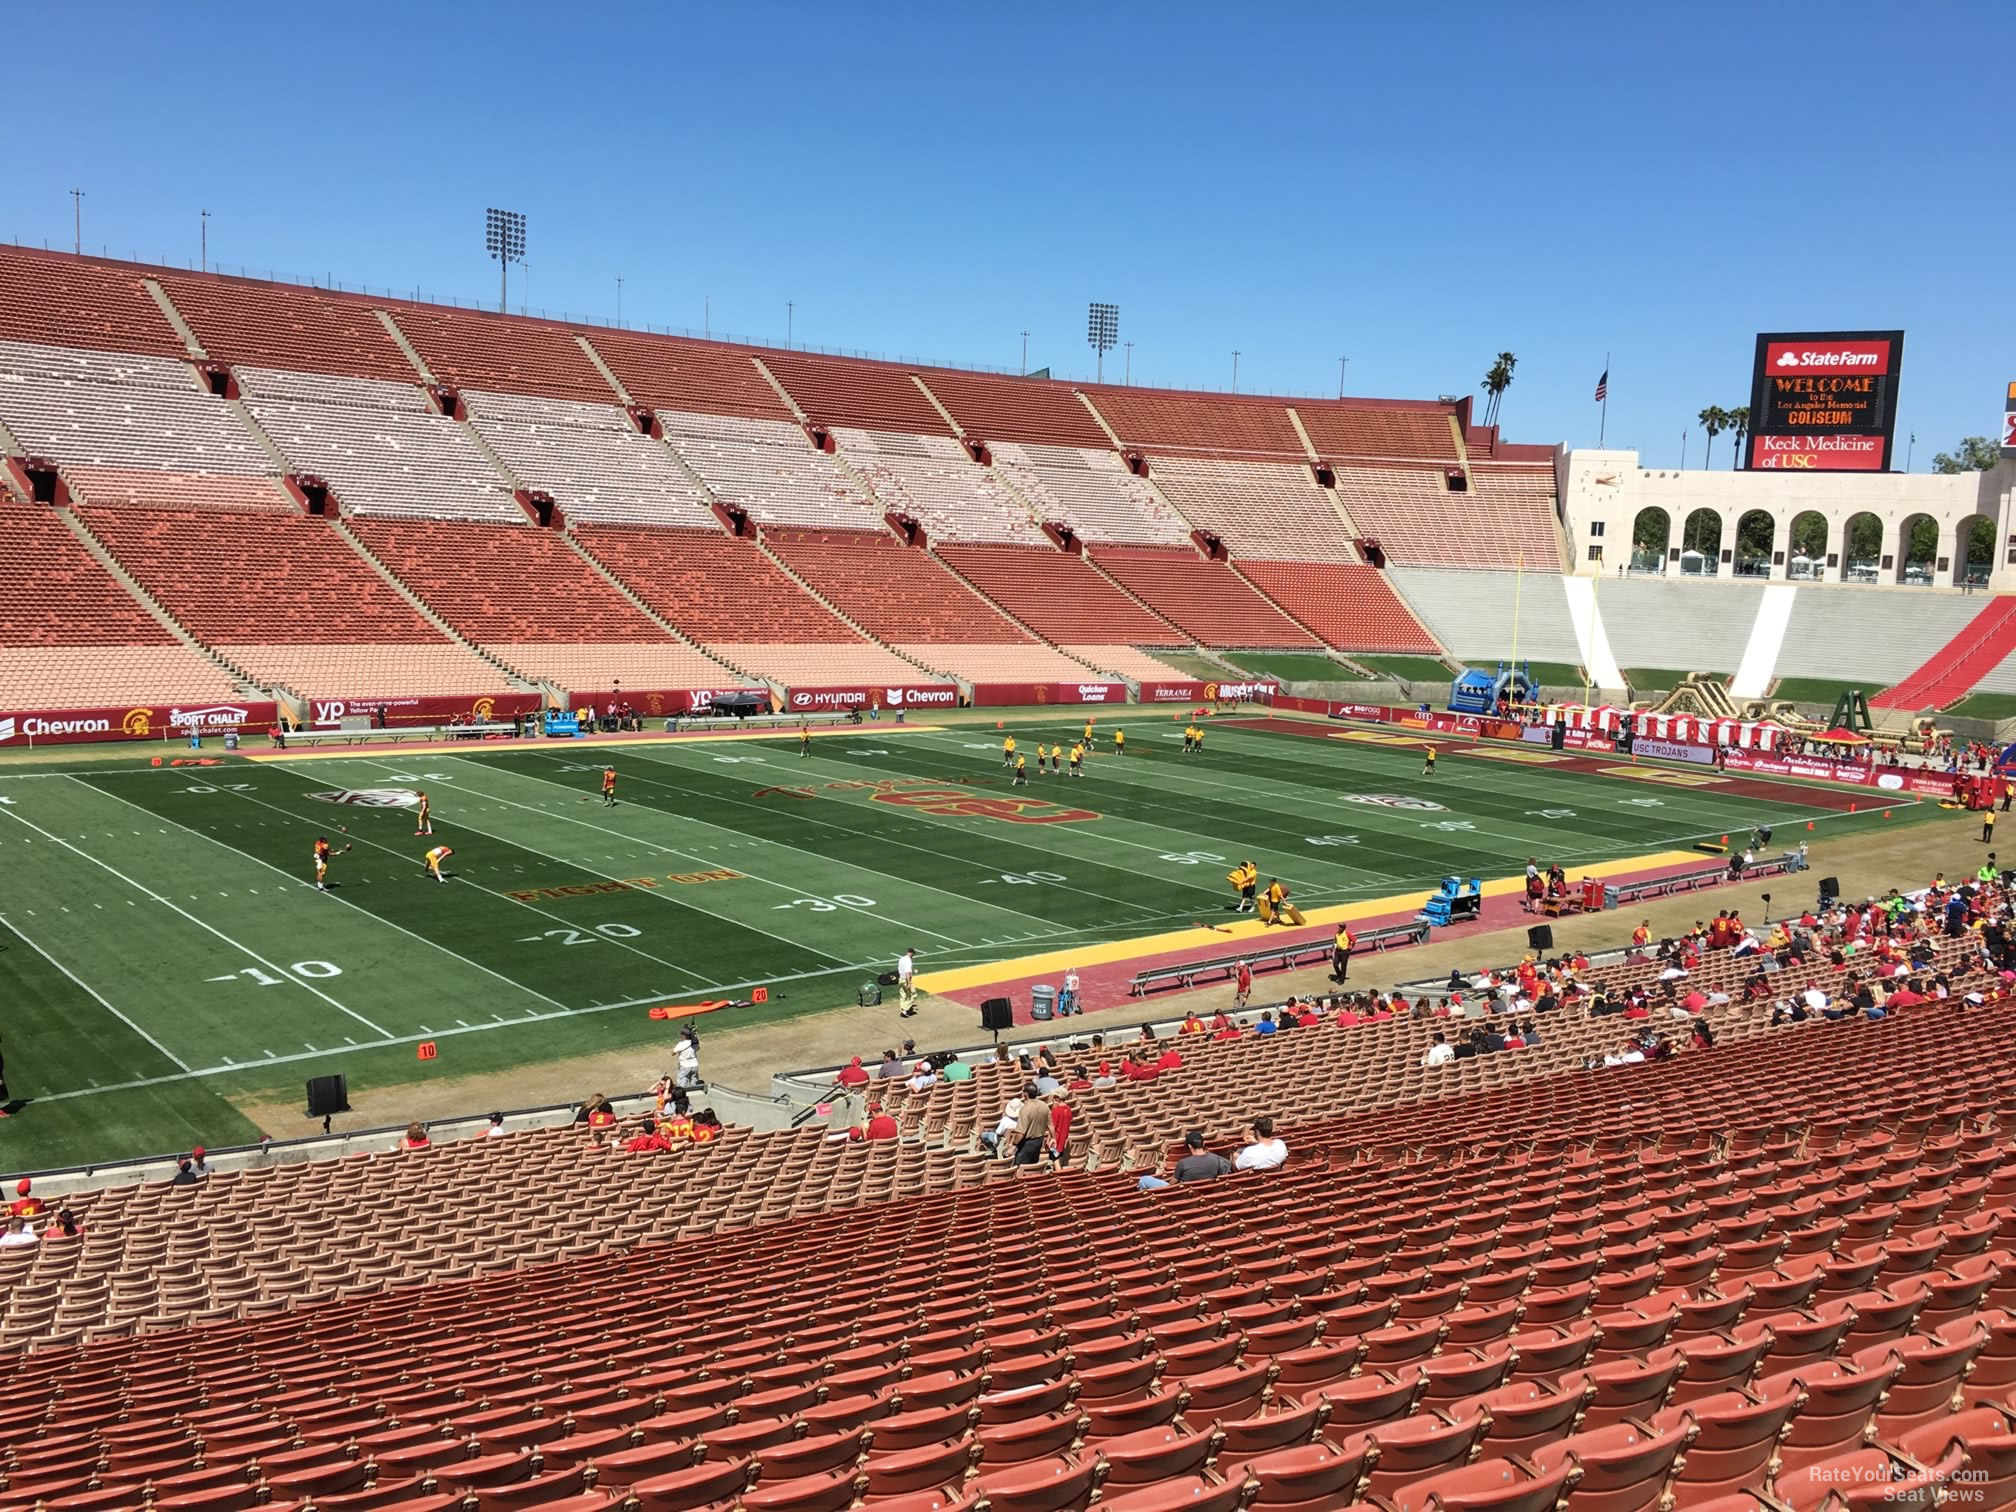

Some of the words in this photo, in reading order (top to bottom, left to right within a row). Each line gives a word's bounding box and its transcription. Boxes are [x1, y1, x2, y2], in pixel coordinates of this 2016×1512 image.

[1775, 378, 1874, 392] WELCOME
[1777, 401, 1792, 409] Los
[1795, 401, 1825, 410] Angeles
[1828, 400, 1867, 409] Memorial
[1788, 411, 1852, 425] COLISEUM
[1763, 436, 1800, 450] Keck
[1806, 436, 1874, 451] Medicine
[1762, 454, 1780, 468] of
[1782, 454, 1817, 468] USC
[906, 689, 953, 703] Chevron
[1078, 685, 1108, 694] Quicken
[1155, 689, 1192, 697] TERRANEA
[690, 690, 712, 706] yp
[815, 692, 865, 703] HYUNDAI
[1082, 693, 1105, 701] Loans
[316, 701, 345, 720] yp
[170, 714, 205, 727] SPORT
[208, 712, 247, 724] CHALET
[23, 718, 109, 736] Chevron
[1634, 743, 1649, 753] USC
[1652, 745, 1688, 758] TROJANS
[1305, 835, 1361, 846] 40
[1158, 851, 1226, 864] 50
[1001, 871, 1067, 884] 40
[503, 876, 662, 902] FIGHT
[667, 868, 747, 884] ON
[792, 894, 877, 911] 30
[1719, 920, 1726, 931] 9
[545, 923, 642, 945] 20
[240, 960, 342, 985] 10
[755, 989, 767, 1001] 20
[422, 1044, 434, 1058] 10
[595, 1115, 604, 1124] 2
[673, 1124, 690, 1138] 13
